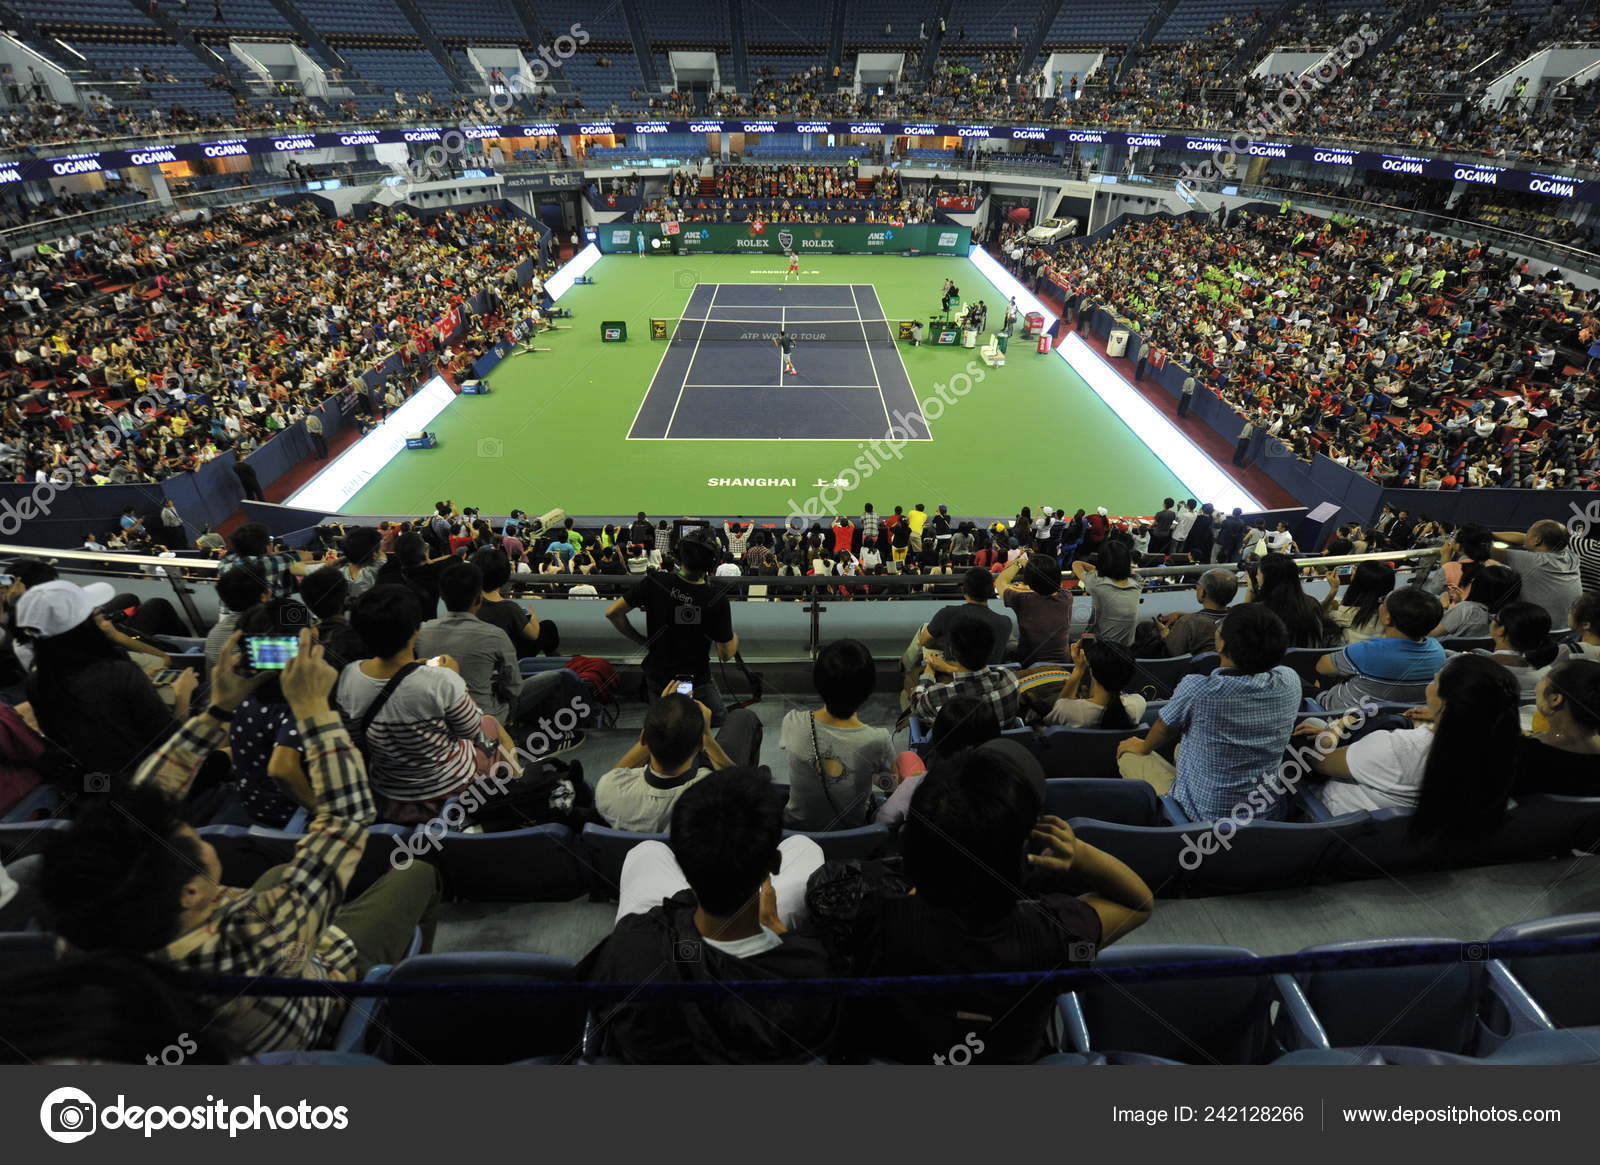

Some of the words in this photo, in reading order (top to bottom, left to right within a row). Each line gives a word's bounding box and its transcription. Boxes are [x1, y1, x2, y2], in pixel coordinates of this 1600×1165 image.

[523, 127, 557, 137] OGAWA
[580, 126, 614, 135] OGAWA
[636, 124, 668, 134] OGAWA
[690, 124, 722, 133] OGAWA
[743, 124, 775, 133] OGAWA
[797, 125, 828, 134] OGAWA
[850, 126, 882, 134] OGAWA
[904, 126, 935, 135] OGAWA
[958, 128, 990, 137] OGAWA
[340, 133, 379, 147] OGAWA
[404, 131, 441, 142] OGAWA
[465, 129, 500, 140] OGAWA
[1013, 130, 1046, 140] OGAWA
[1069, 133, 1102, 143] OGAWA
[273, 138, 315, 151] OGAWA
[1127, 136, 1161, 147] OGAWA
[1186, 141, 1222, 152] OGAWA
[204, 142, 247, 157] OGAWA
[1249, 145, 1286, 157] OGAWA
[131, 149, 176, 165] OGAWA
[1314, 151, 1353, 165] OGAWA
[52, 157, 101, 175] OGAWA
[1382, 159, 1423, 174] OGAWA
[0, 169, 22, 184] WA
[1454, 168, 1497, 185] OGAWA
[1529, 178, 1574, 197] OGAWA
[736, 239, 769, 247] ROLEX
[802, 239, 834, 247] ROLEX
[707, 478, 797, 487] SHANGHAI
